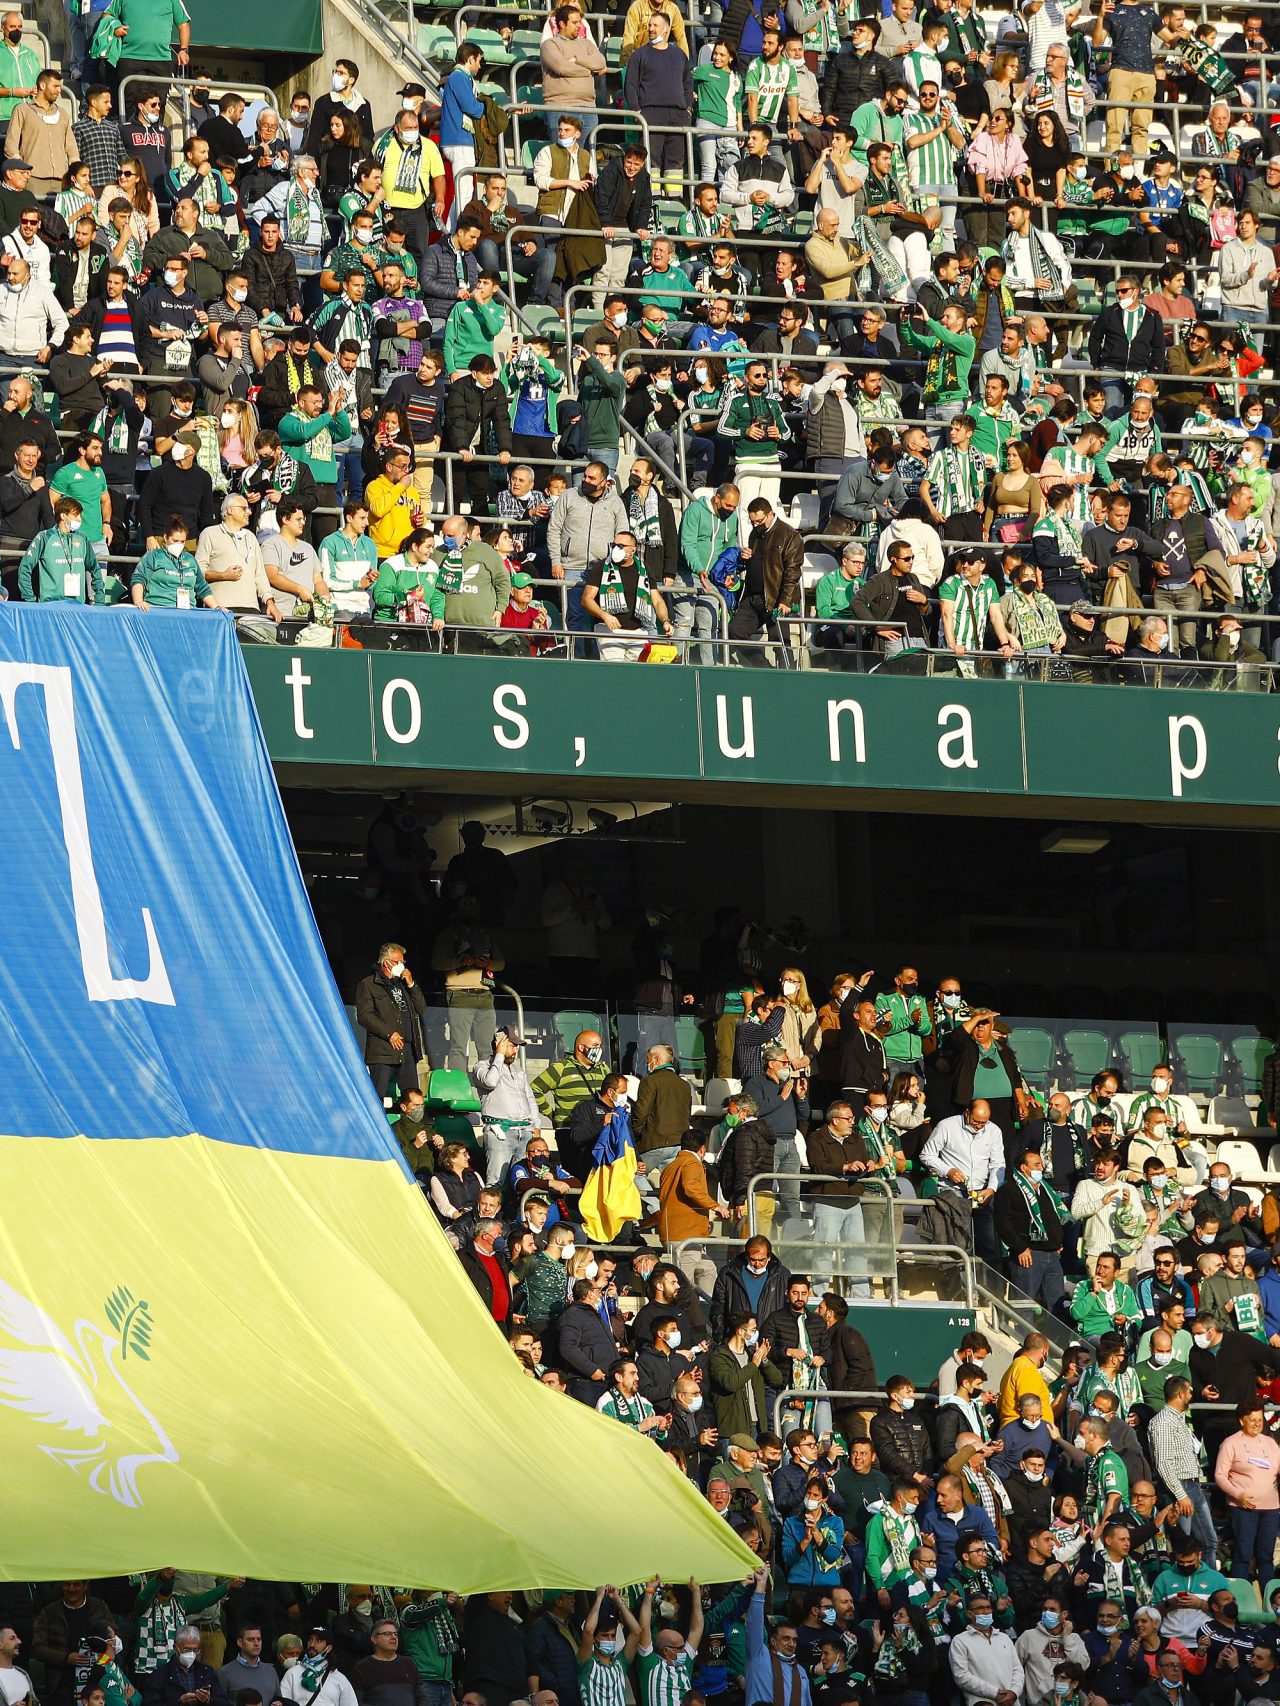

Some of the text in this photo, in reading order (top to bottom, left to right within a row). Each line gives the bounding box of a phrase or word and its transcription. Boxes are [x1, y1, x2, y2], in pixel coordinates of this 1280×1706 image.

[717, 695, 979, 769] una
[948, 1317, 970, 1326] A 128
